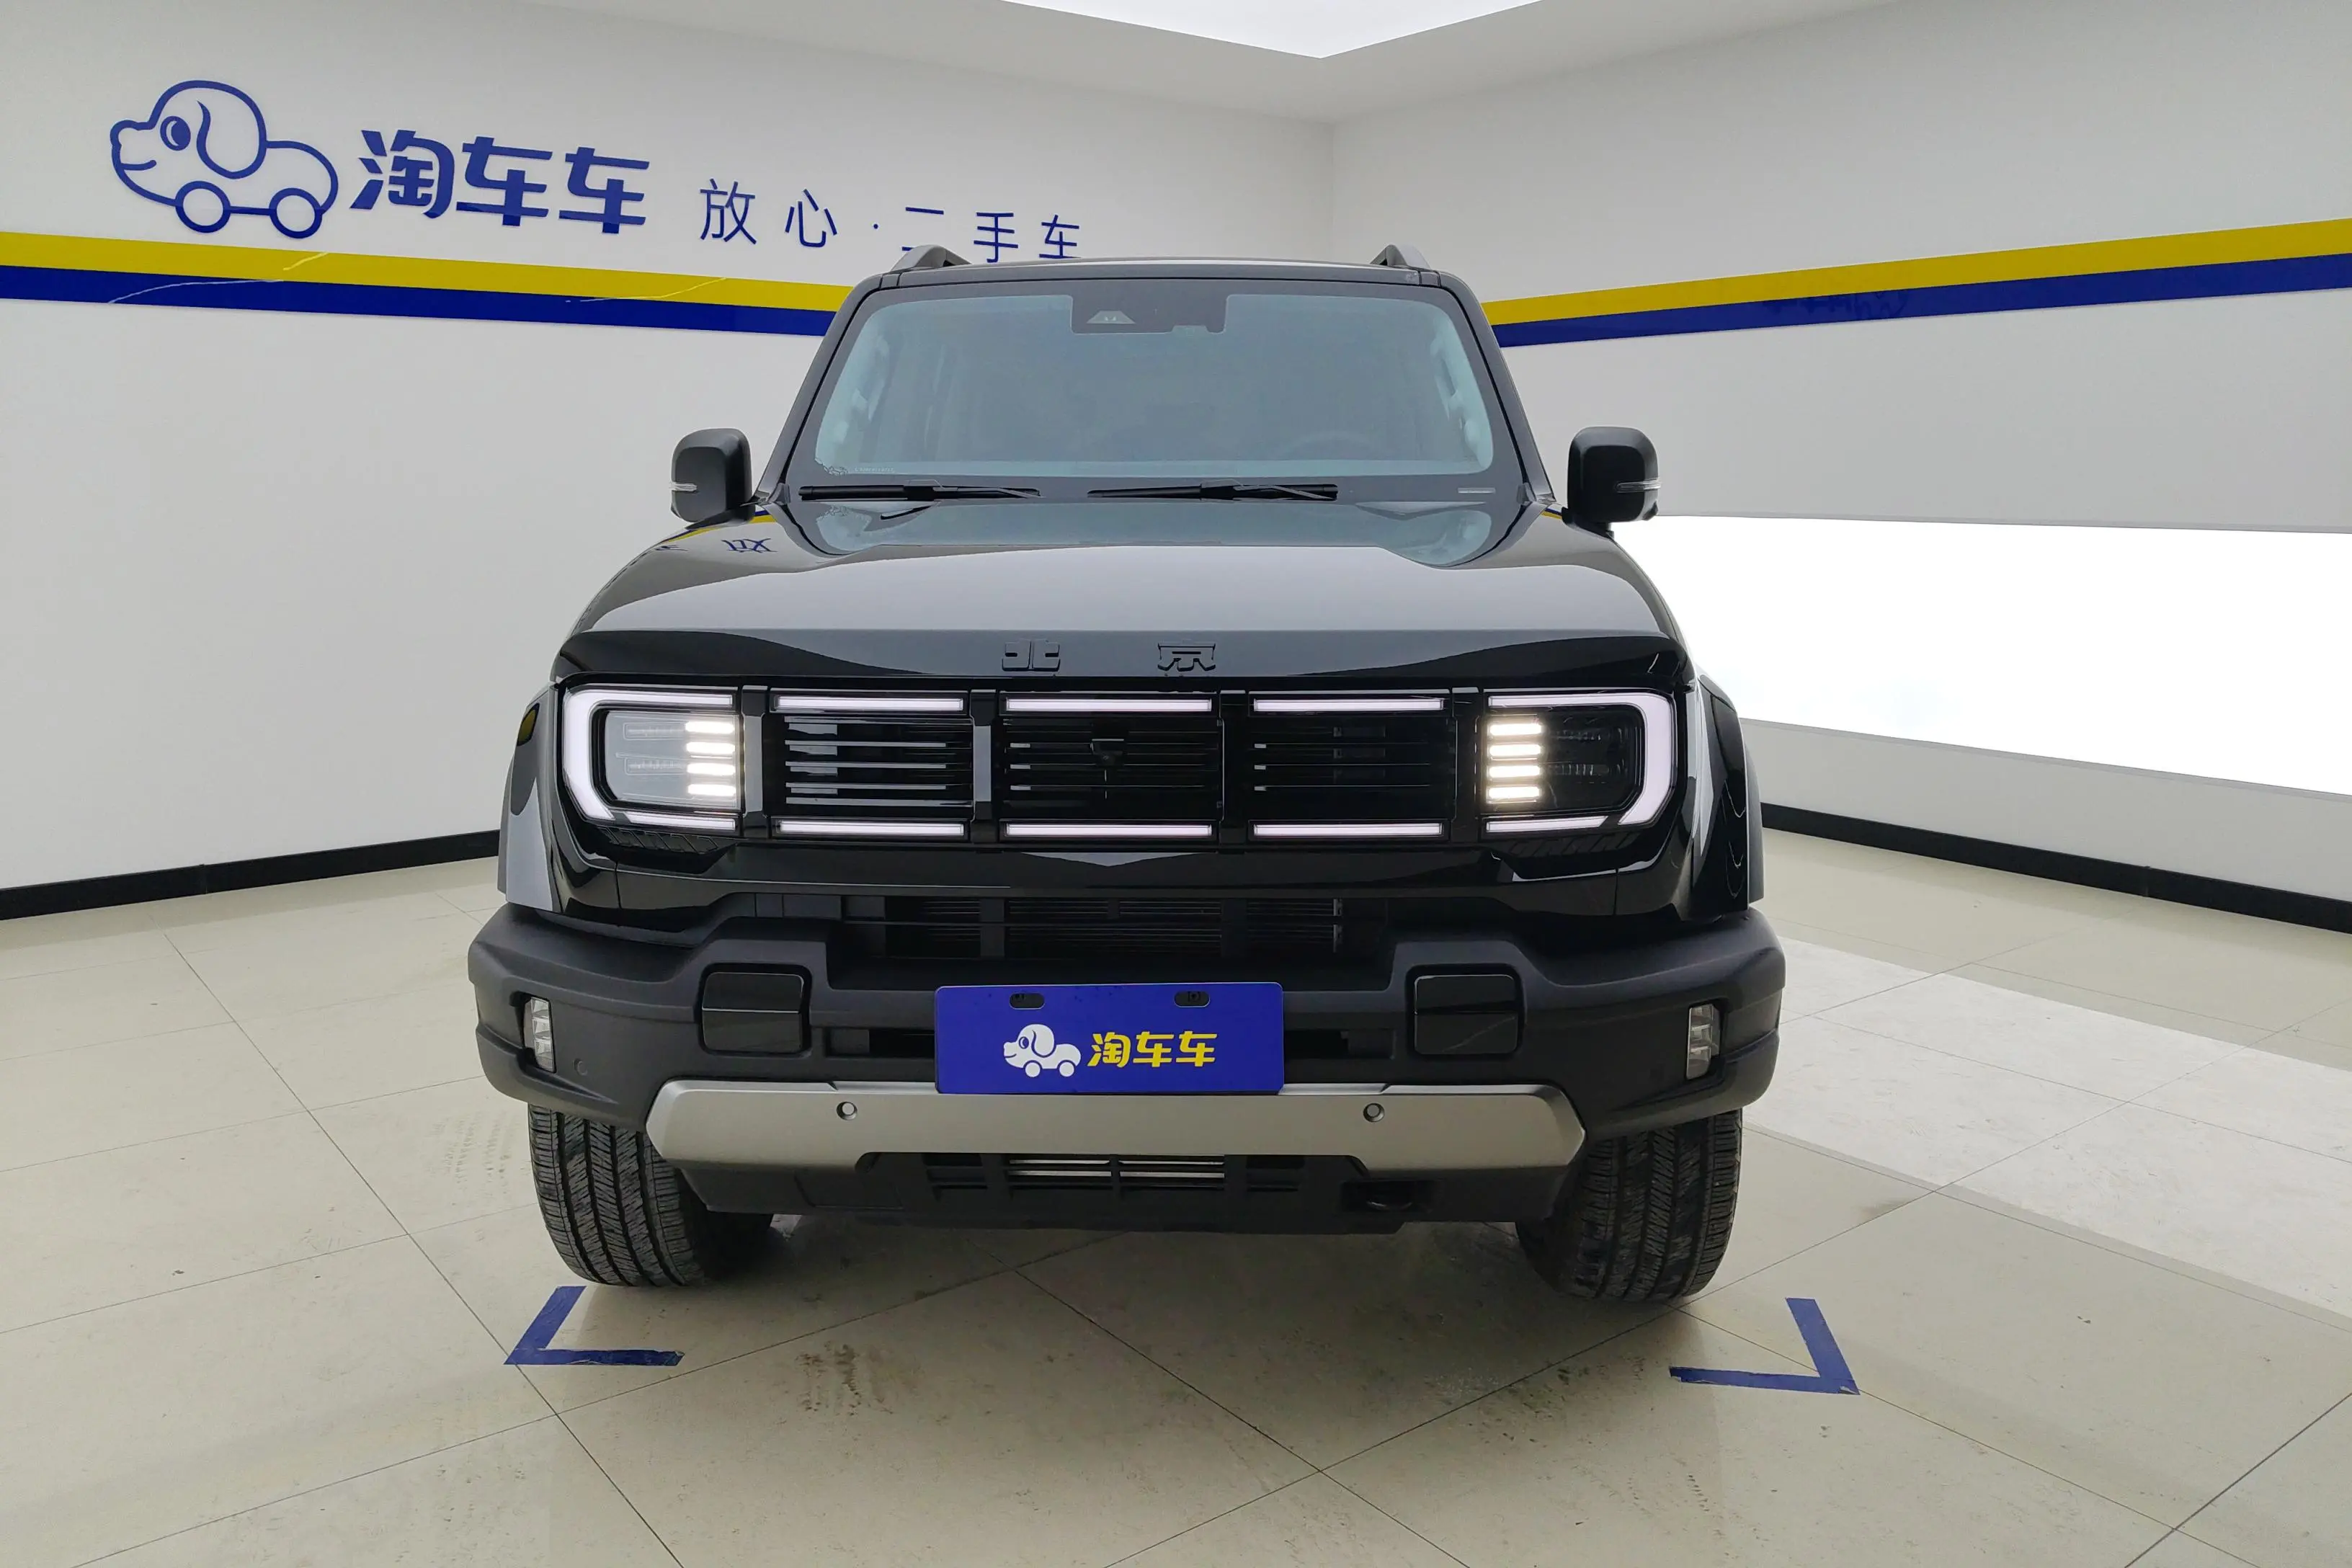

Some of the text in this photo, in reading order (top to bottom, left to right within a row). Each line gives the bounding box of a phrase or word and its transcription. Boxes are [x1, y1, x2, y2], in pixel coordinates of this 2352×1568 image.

[350, 130, 650, 233] 淘车车
[1087, 1030, 1217, 1067] 淘车车
